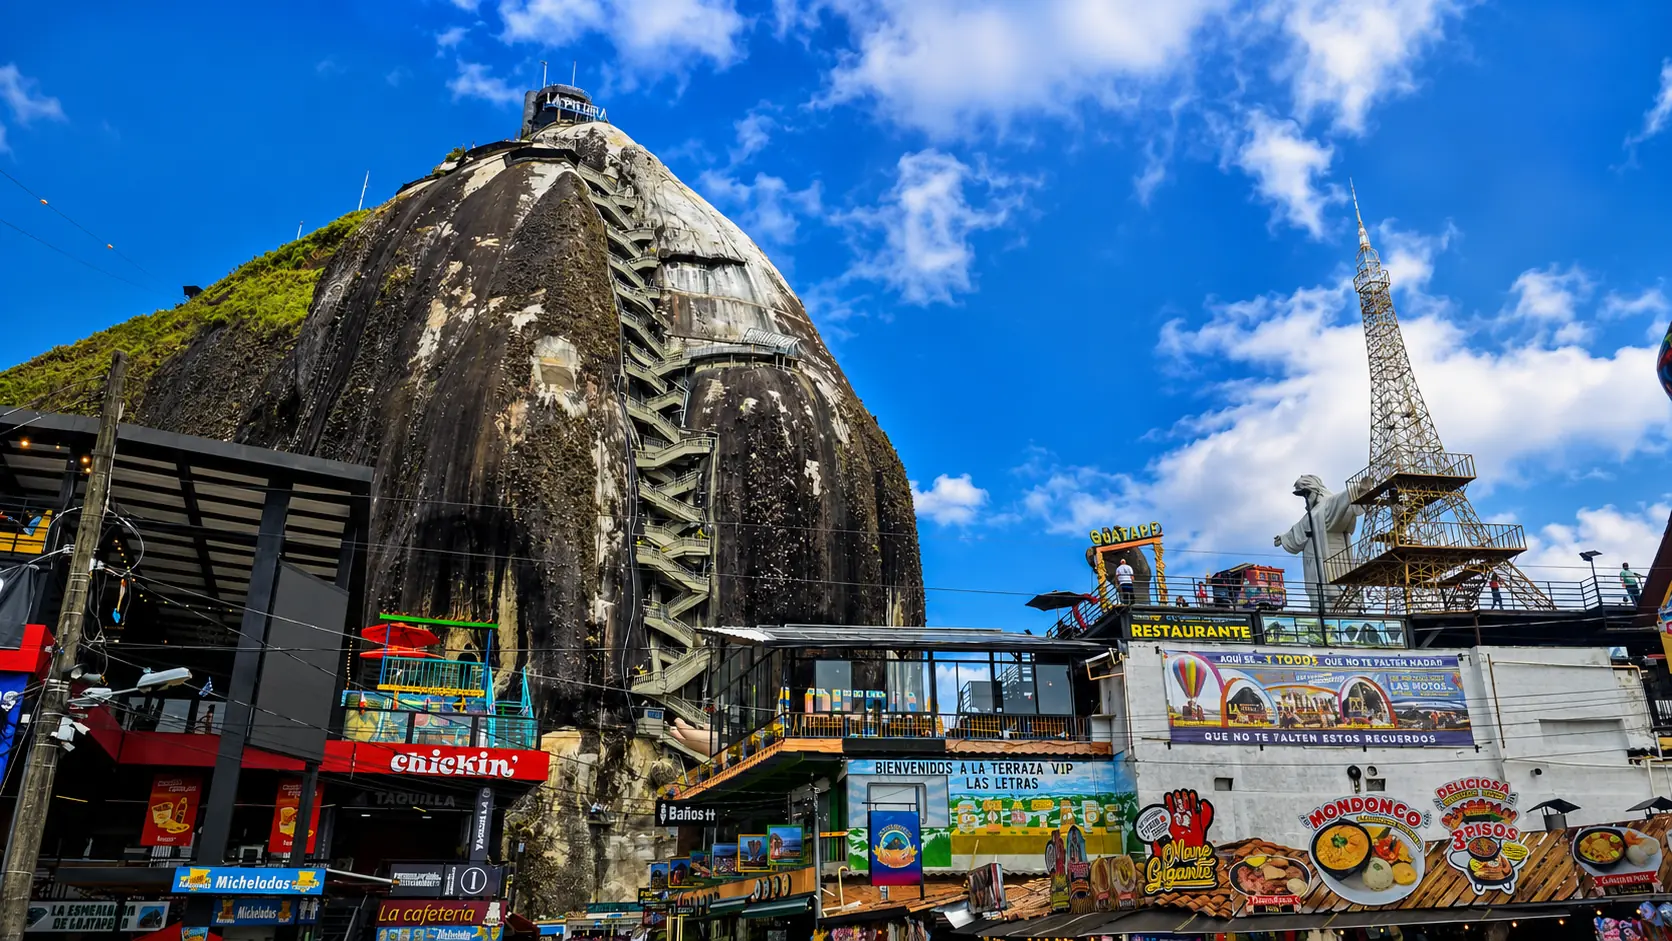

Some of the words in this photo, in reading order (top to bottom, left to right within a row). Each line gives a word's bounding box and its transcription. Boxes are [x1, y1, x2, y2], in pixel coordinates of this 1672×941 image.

[1131, 624, 1251, 638] RESTAURANTE
[1324, 657, 1343, 666] QUE
[1204, 732, 1228, 742] QUE
[1233, 732, 1250, 742] NO
[1254, 733, 1268, 742] TE
[1323, 734, 1360, 743] ESTOS
[1365, 735, 1436, 743] RECUERDOS
[875, 761, 953, 774] BIENVENIDOS
[960, 762, 967, 774] A
[971, 762, 985, 774] LA
[992, 762, 1043, 775] TERRAZA
[1051, 763, 1074, 774] VIP
[966, 777, 989, 789] LAS
[995, 777, 1039, 790] LETRAS
[1436, 778, 1509, 799] DELICIOSA
[374, 792, 455, 807] TAQUILLA
[669, 806, 704, 820] Baños
[1452, 829, 1467, 850] 3
[215, 875, 291, 889] Micheladas
[237, 905, 277, 920] Micheladas
[378, 904, 400, 922] La
